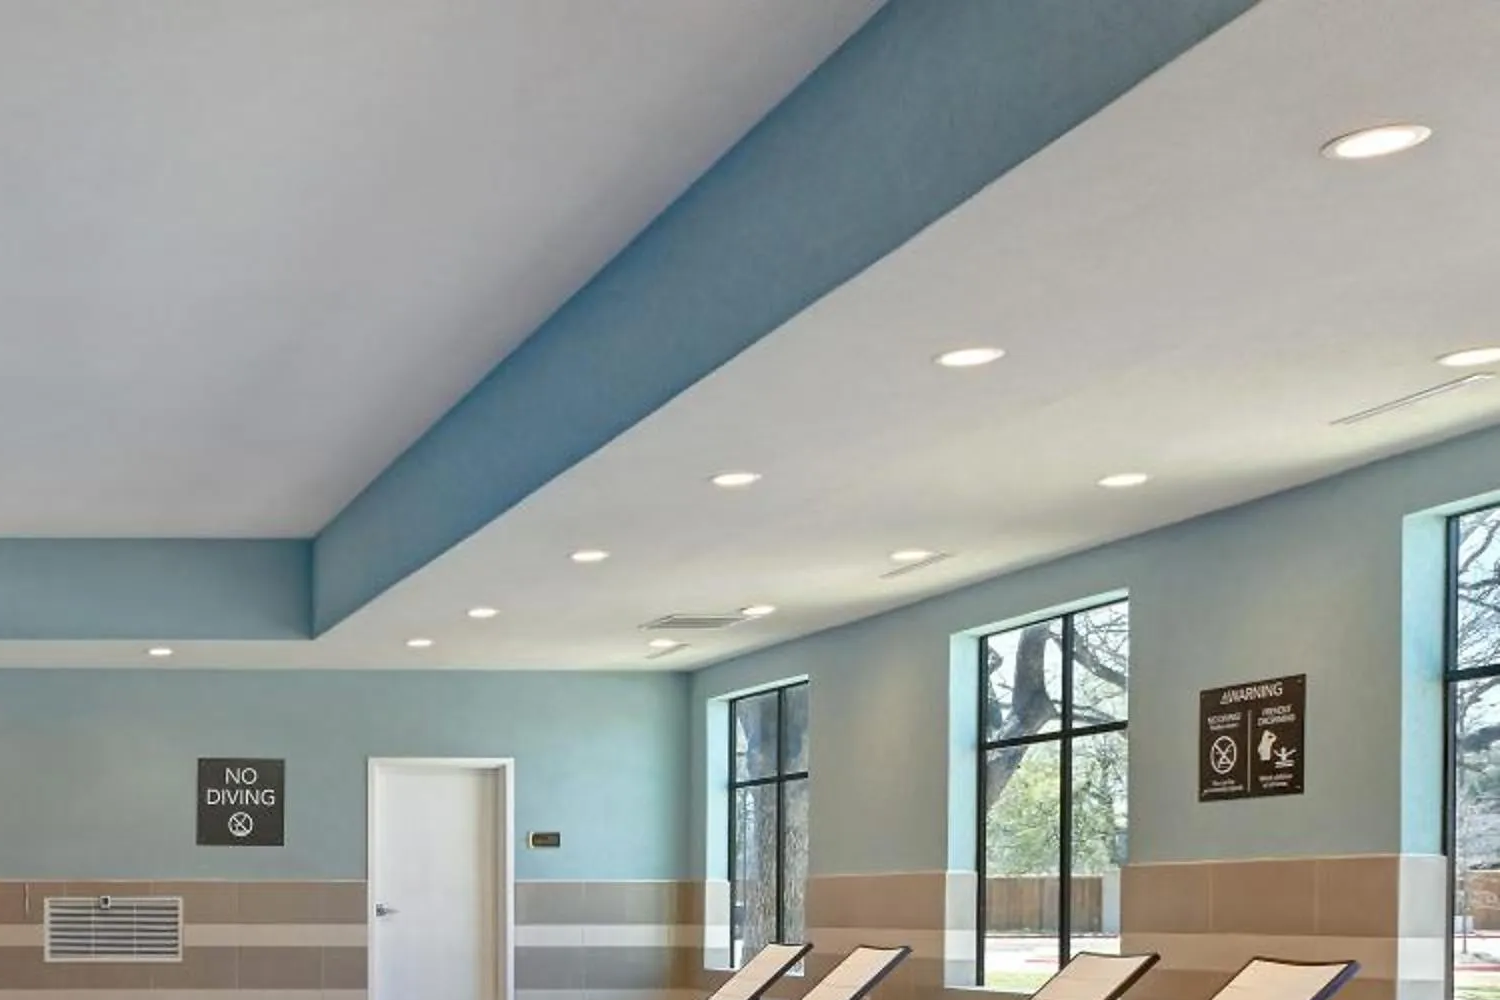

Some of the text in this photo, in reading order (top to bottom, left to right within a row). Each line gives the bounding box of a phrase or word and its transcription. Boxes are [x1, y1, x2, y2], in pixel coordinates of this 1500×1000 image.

[1227, 681, 1284, 703] WARNING
[224, 767, 257, 785] NO
[206, 788, 276, 806] DIVING
